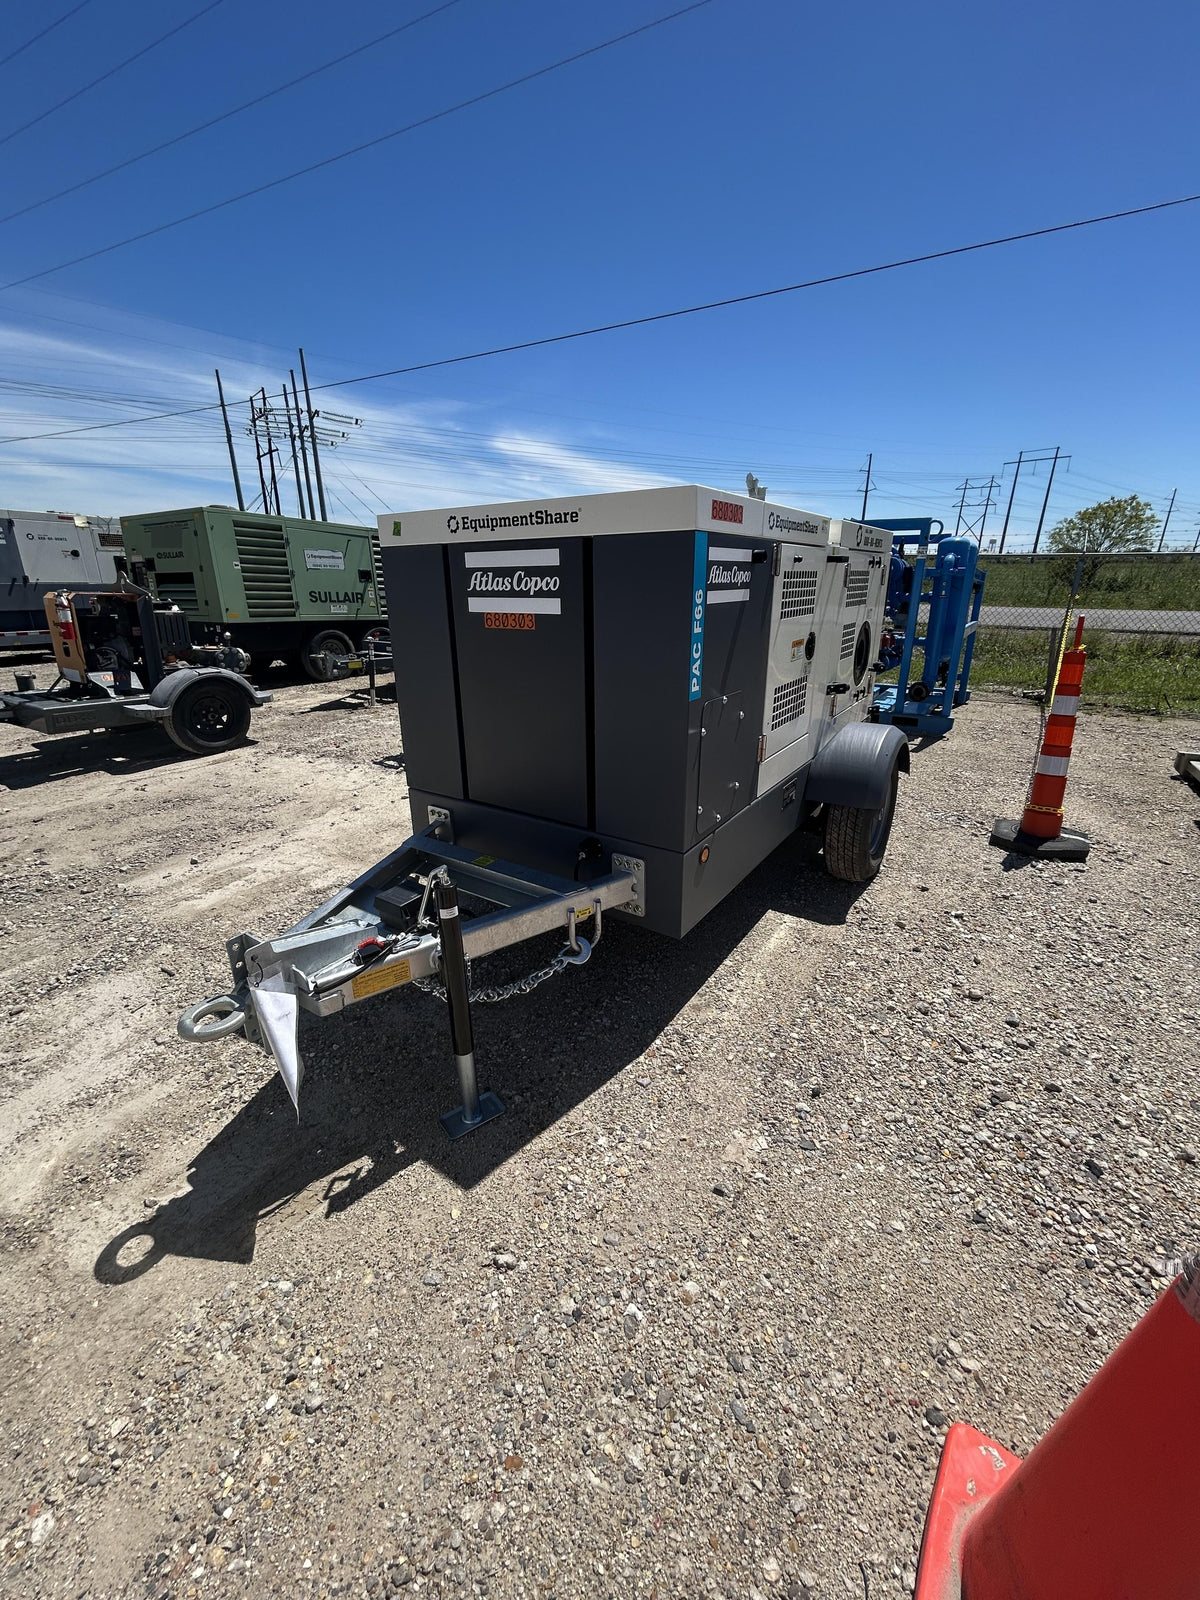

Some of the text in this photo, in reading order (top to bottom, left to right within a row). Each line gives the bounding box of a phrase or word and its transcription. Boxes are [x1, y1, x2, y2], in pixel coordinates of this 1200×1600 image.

[461, 509, 579, 532] EquipmentShare
[712, 500, 743, 523] 680303
[774, 513, 818, 536] EquipmentShare
[467, 570, 560, 595] Atlas Copco
[707, 565, 751, 587] Atlas Copco
[308, 590, 365, 603] SULLAIR
[485, 612, 535, 630] 680303
[689, 588, 704, 694] PAC F66
